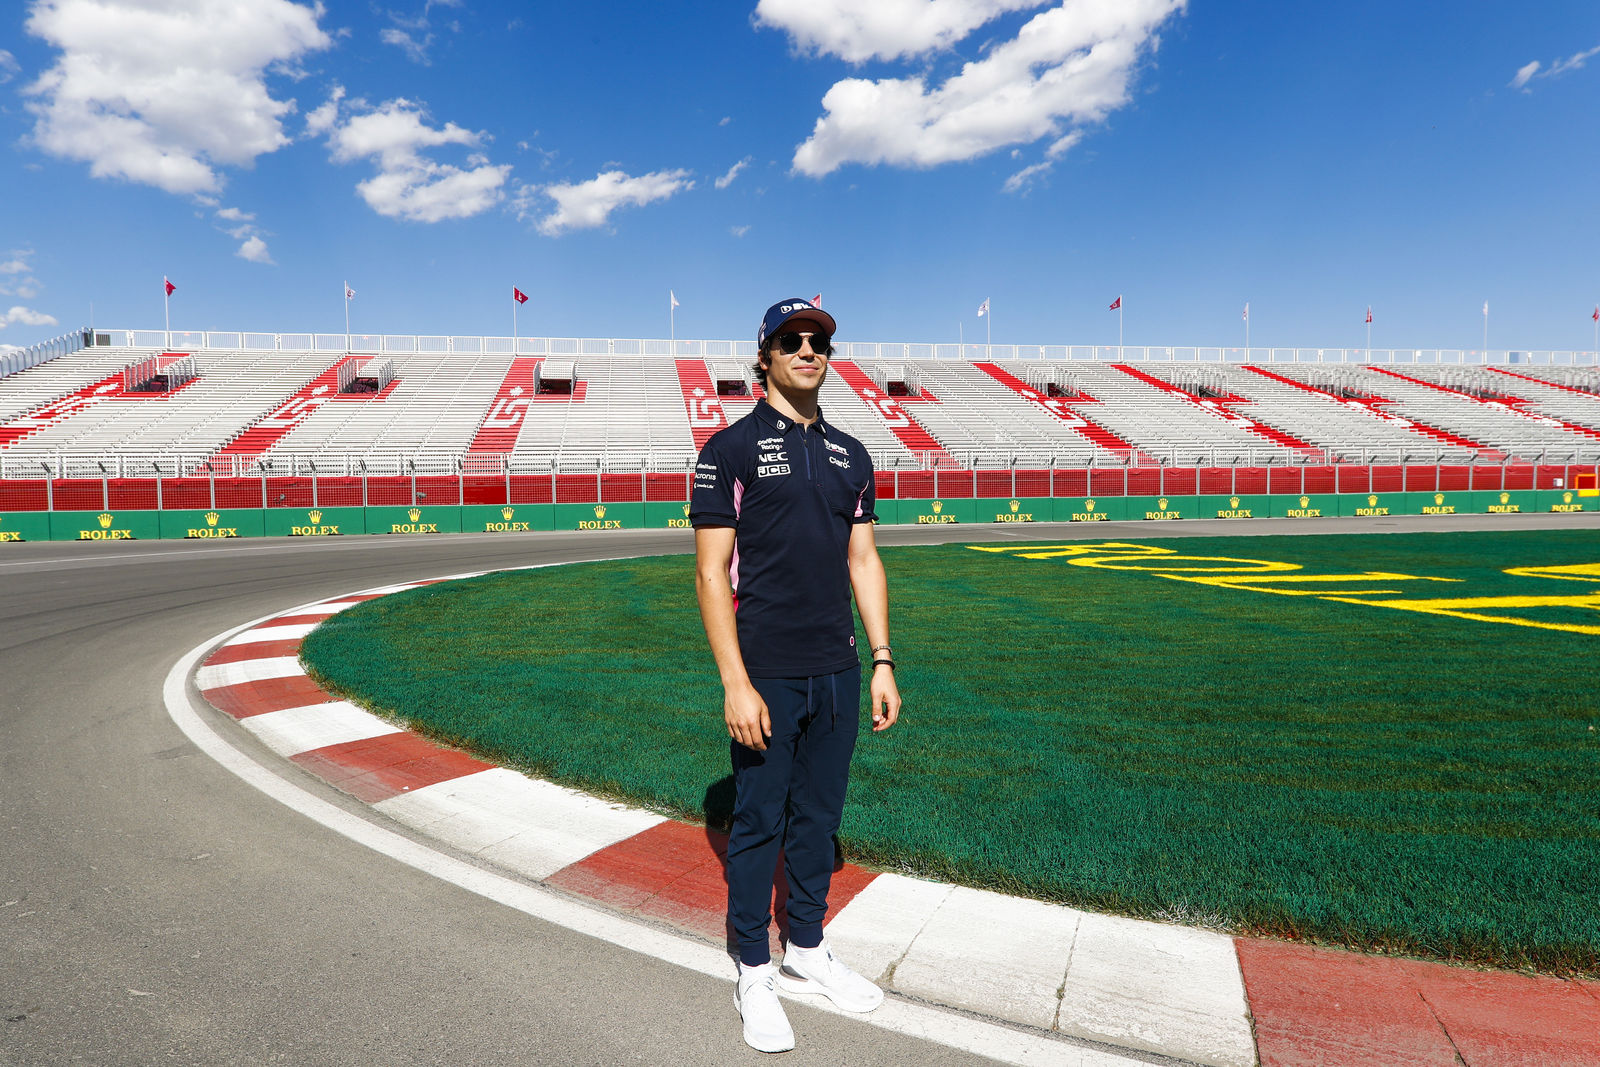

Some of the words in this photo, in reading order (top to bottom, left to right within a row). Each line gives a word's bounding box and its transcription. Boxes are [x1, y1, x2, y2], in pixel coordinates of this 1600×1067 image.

[758, 451, 788, 463] NEC
[759, 465, 789, 476] JCB
[1356, 508, 1389, 517] ROLEX
[1422, 506, 1455, 515] ROLEX
[1488, 504, 1519, 514] ROLEX
[1551, 504, 1583, 513] ROLEX
[997, 513, 1033, 523] ROLEX
[1072, 513, 1107, 522] ROLEX
[1146, 511, 1180, 521] ROLEX
[1218, 510, 1252, 520] ROLEX
[1287, 509, 1321, 519] ROLEX
[579, 520, 621, 530] ROLEX
[918, 515, 956, 525] ROLEX
[292, 525, 339, 536] ROLEX
[392, 523, 437, 534] ROLEX
[486, 522, 530, 533] ROLEX
[80, 529, 132, 540] ROLEX
[187, 528, 237, 539] ROLEX
